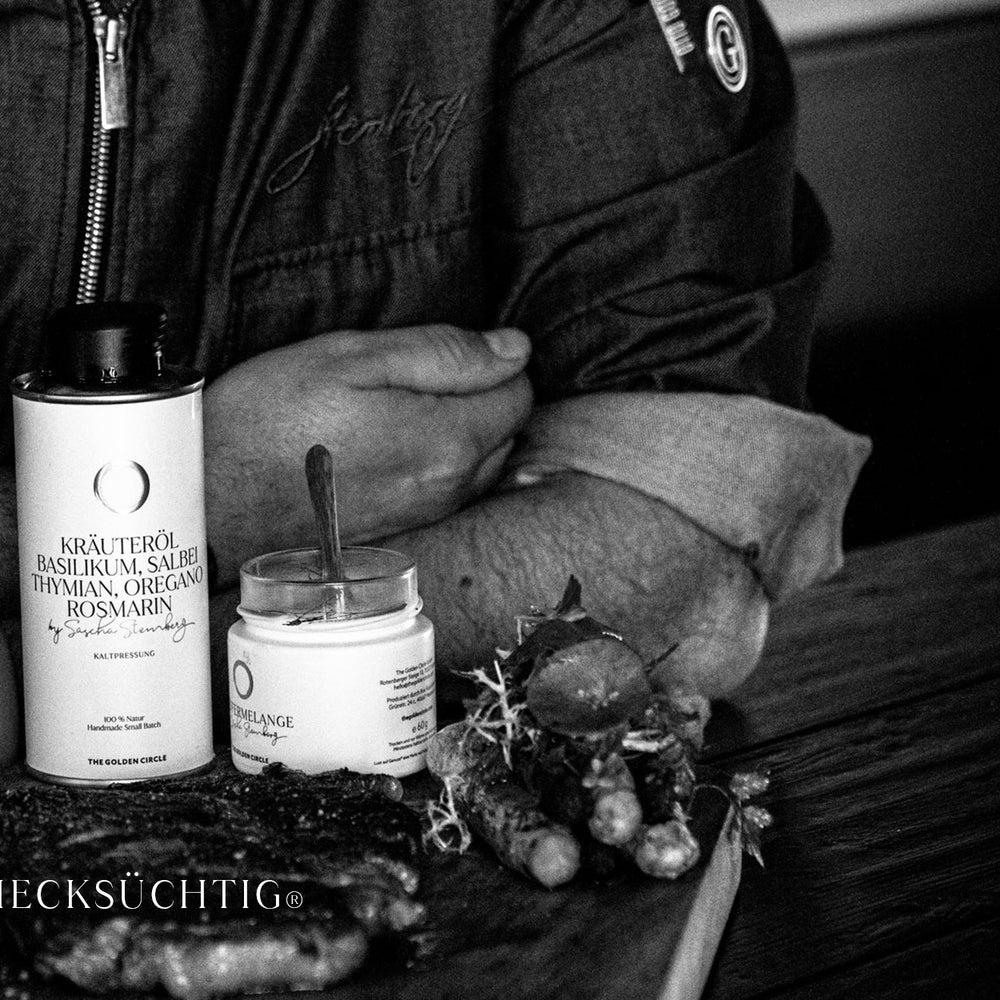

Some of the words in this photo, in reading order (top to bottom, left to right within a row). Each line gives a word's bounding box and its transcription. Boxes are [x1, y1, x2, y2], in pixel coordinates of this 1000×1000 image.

[61, 529, 179, 555] KRÄUTERÖL
[37, 554, 143, 576] BASILIKUM,
[147, 546, 198, 573] SALBEI
[31, 573, 119, 598] THYMIAN,
[124, 565, 203, 595] OREGANO
[67, 595, 172, 618] ROSMARIN
[48, 619, 63, 645] by
[93, 650, 156, 660] KALTPRESSUNG
[144, 721, 161, 729] Batch
[88, 758, 103, 766] THE
[105, 757, 139, 766] GOLDEN
[140, 754, 167, 764] CIRCLE
